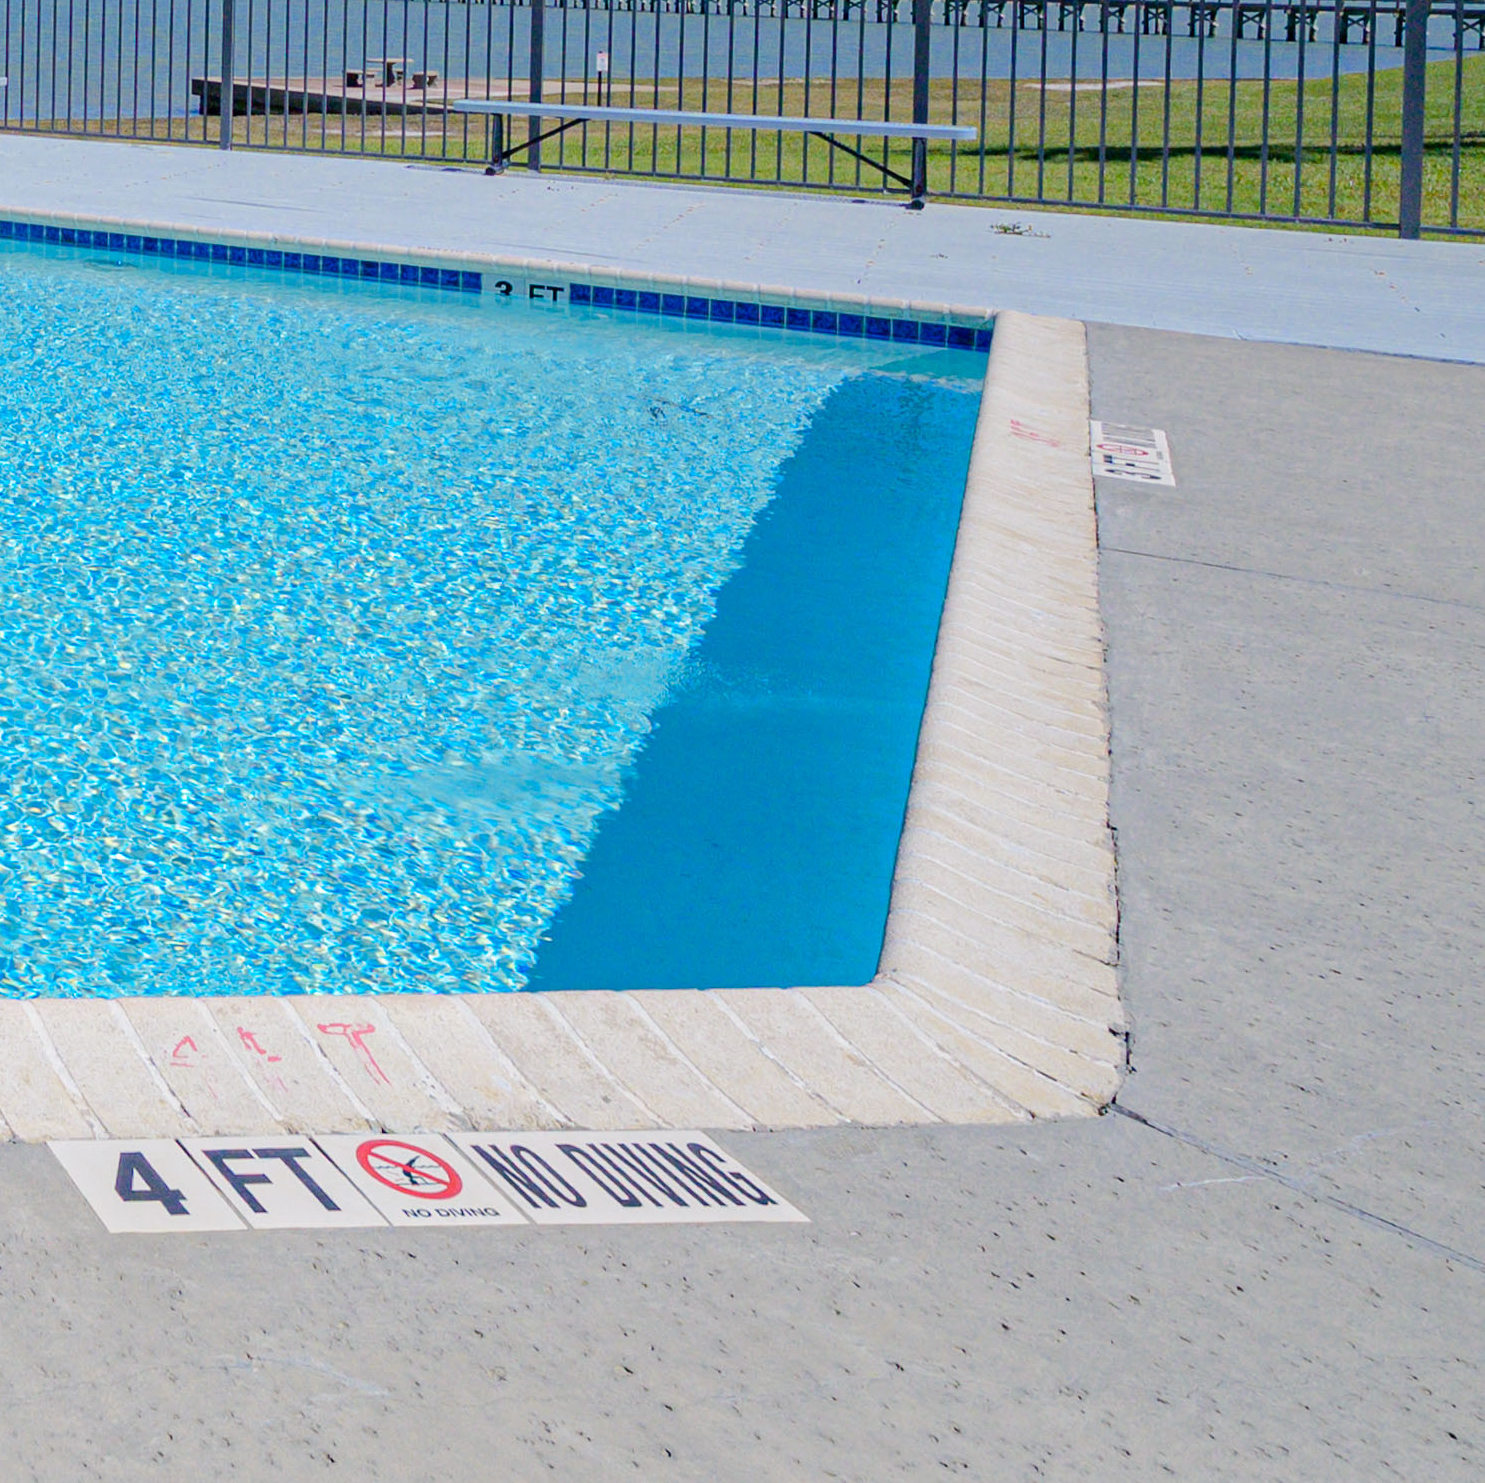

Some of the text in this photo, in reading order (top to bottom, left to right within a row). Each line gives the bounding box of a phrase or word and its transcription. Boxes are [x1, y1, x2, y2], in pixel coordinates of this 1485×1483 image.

[495, 281, 564, 302] 3 FT
[115, 1143, 779, 1215] 4 FT NO DIVING
[402, 1208, 501, 1218] NO DIVING
